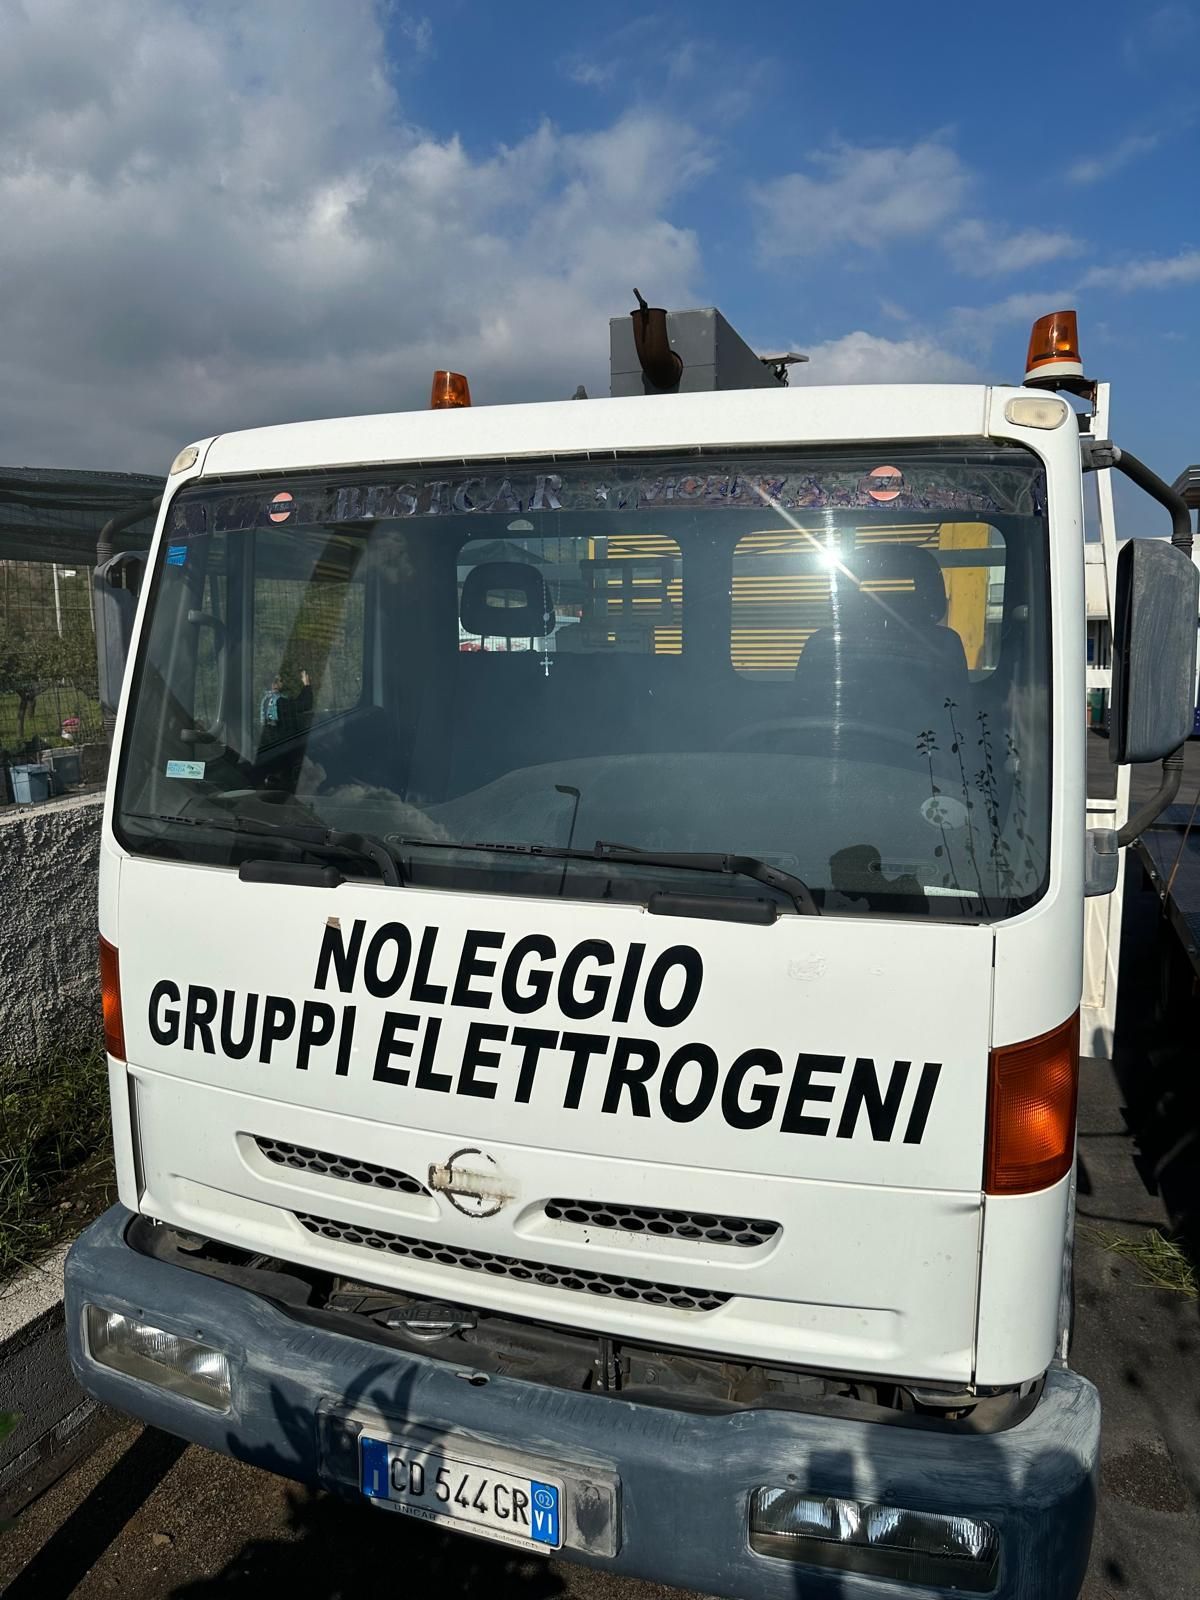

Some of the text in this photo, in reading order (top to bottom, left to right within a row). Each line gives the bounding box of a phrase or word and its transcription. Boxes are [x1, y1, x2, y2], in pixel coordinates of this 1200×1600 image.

[314, 917, 704, 1028] NOLEGGIO
[148, 979, 943, 1145] GRUPPI ELETTROGENI
[390, 1457, 530, 1526] CD 544GR
[534, 1509, 553, 1534] VI
